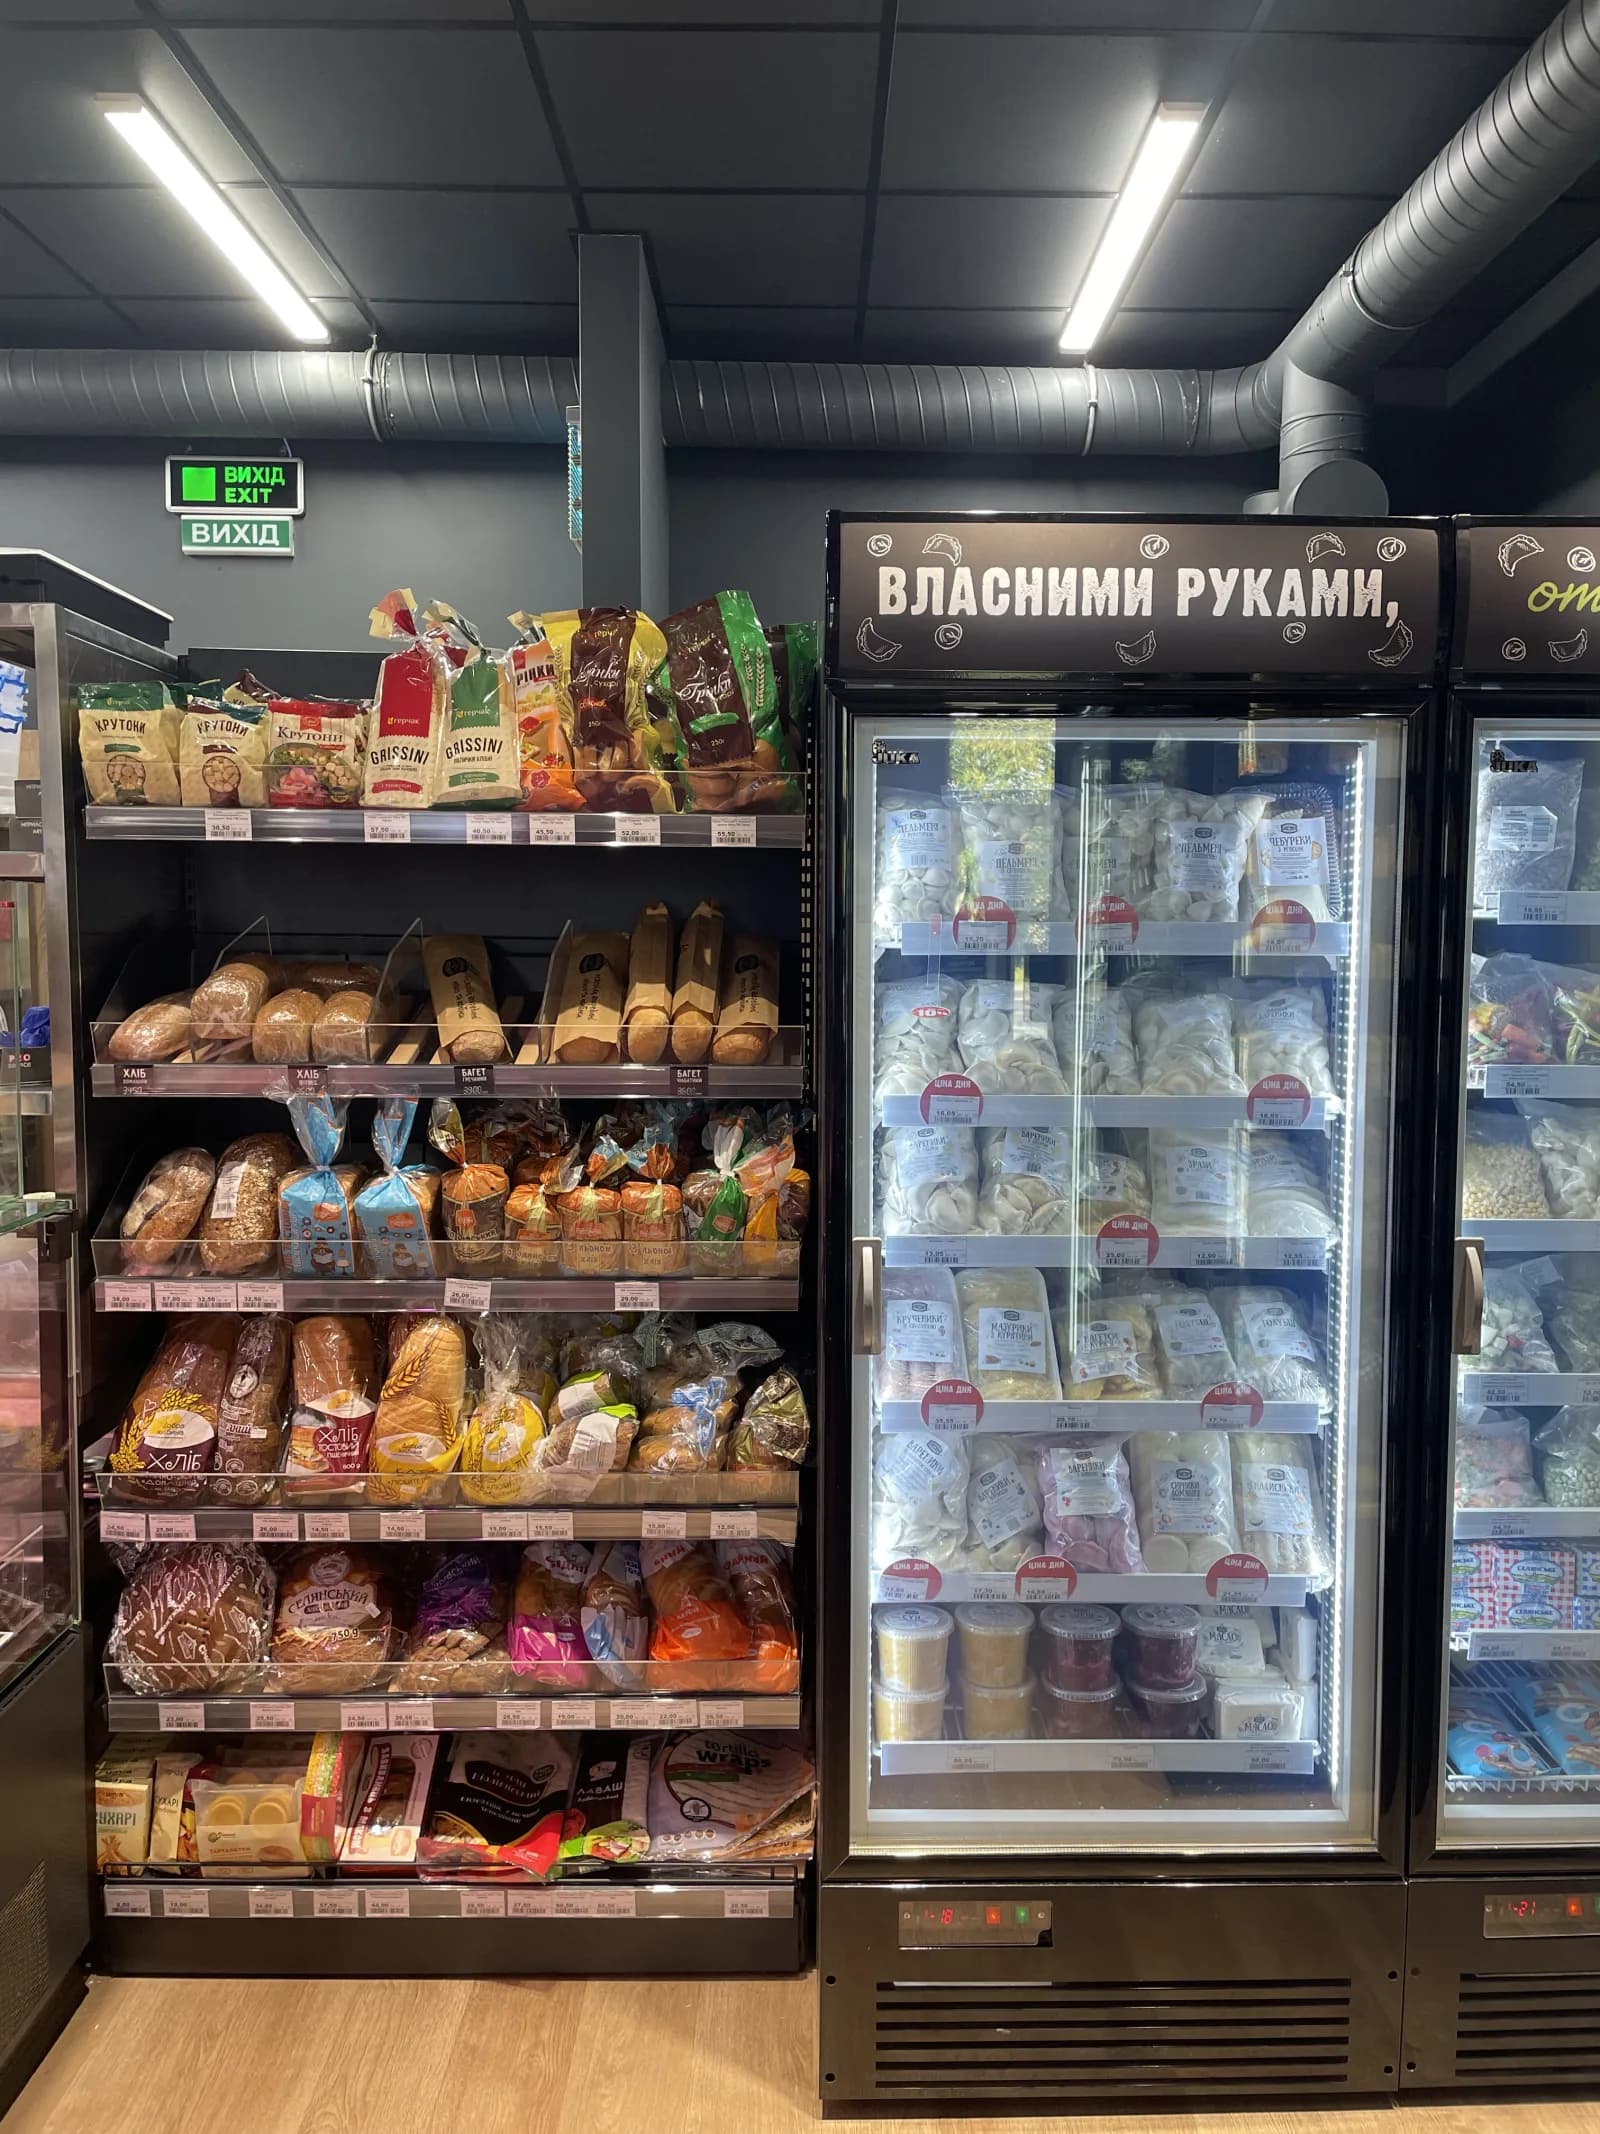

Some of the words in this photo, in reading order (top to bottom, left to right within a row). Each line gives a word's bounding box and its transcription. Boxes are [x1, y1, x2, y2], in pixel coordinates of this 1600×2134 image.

[224, 466, 285, 485] ВИХІД
[224, 488, 272, 504] EXIT
[191, 523, 280, 546] ВИХІД
[878, 566, 1153, 617] ВЛАСНИМИ
[1176, 566, 1399, 627] РУКАМИ,
[95, 719, 146, 734] КРУТОНИ
[197, 719, 249, 737] КРУТОНИ
[446, 737, 503, 759] GRISSINI
[370, 746, 430, 766] GRISSINI
[123, 1069, 146, 1079] ХЛІБ
[296, 1070, 319, 1079] ХЛІБ
[462, 1068, 486, 1078] БАГЕТ
[677, 1069, 702, 1078] БАГЕТ
[935, 1080, 953, 1088] ЦІНА
[954, 1080, 972, 1089] ДНЯ
[1262, 1080, 1281, 1089] ЦІНА
[1282, 1080, 1300, 1089] ДНЯ
[1111, 1221, 1130, 1229] ЦІНА
[1131, 1222, 1148, 1230] ДНЯ
[936, 1385, 953, 1393] ЦІНА
[955, 1386, 972, 1394] ДНЯ
[319, 1425, 359, 1443] ХЛІБ
[317, 1441, 360, 1452] ТОСТОВИЙ
[147, 1450, 203, 1471] ХЛІБ
[893, 1562, 911, 1570] ЦІНА
[1048, 1561, 1065, 1569] ДНЯ
[1224, 1558, 1242, 1567] ЦІНА
[1243, 1561, 1261, 1569] ДНЯ
[288, 1588, 369, 1614] СЕЛЯНСЬКИЙ
[331, 1629, 350, 1641] 750
[351, 1628, 359, 1638] g
[704, 1740, 759, 1757] tortilla
[696, 1750, 771, 1776] wraps
[576, 1782, 623, 1795] ЛАВАШ
